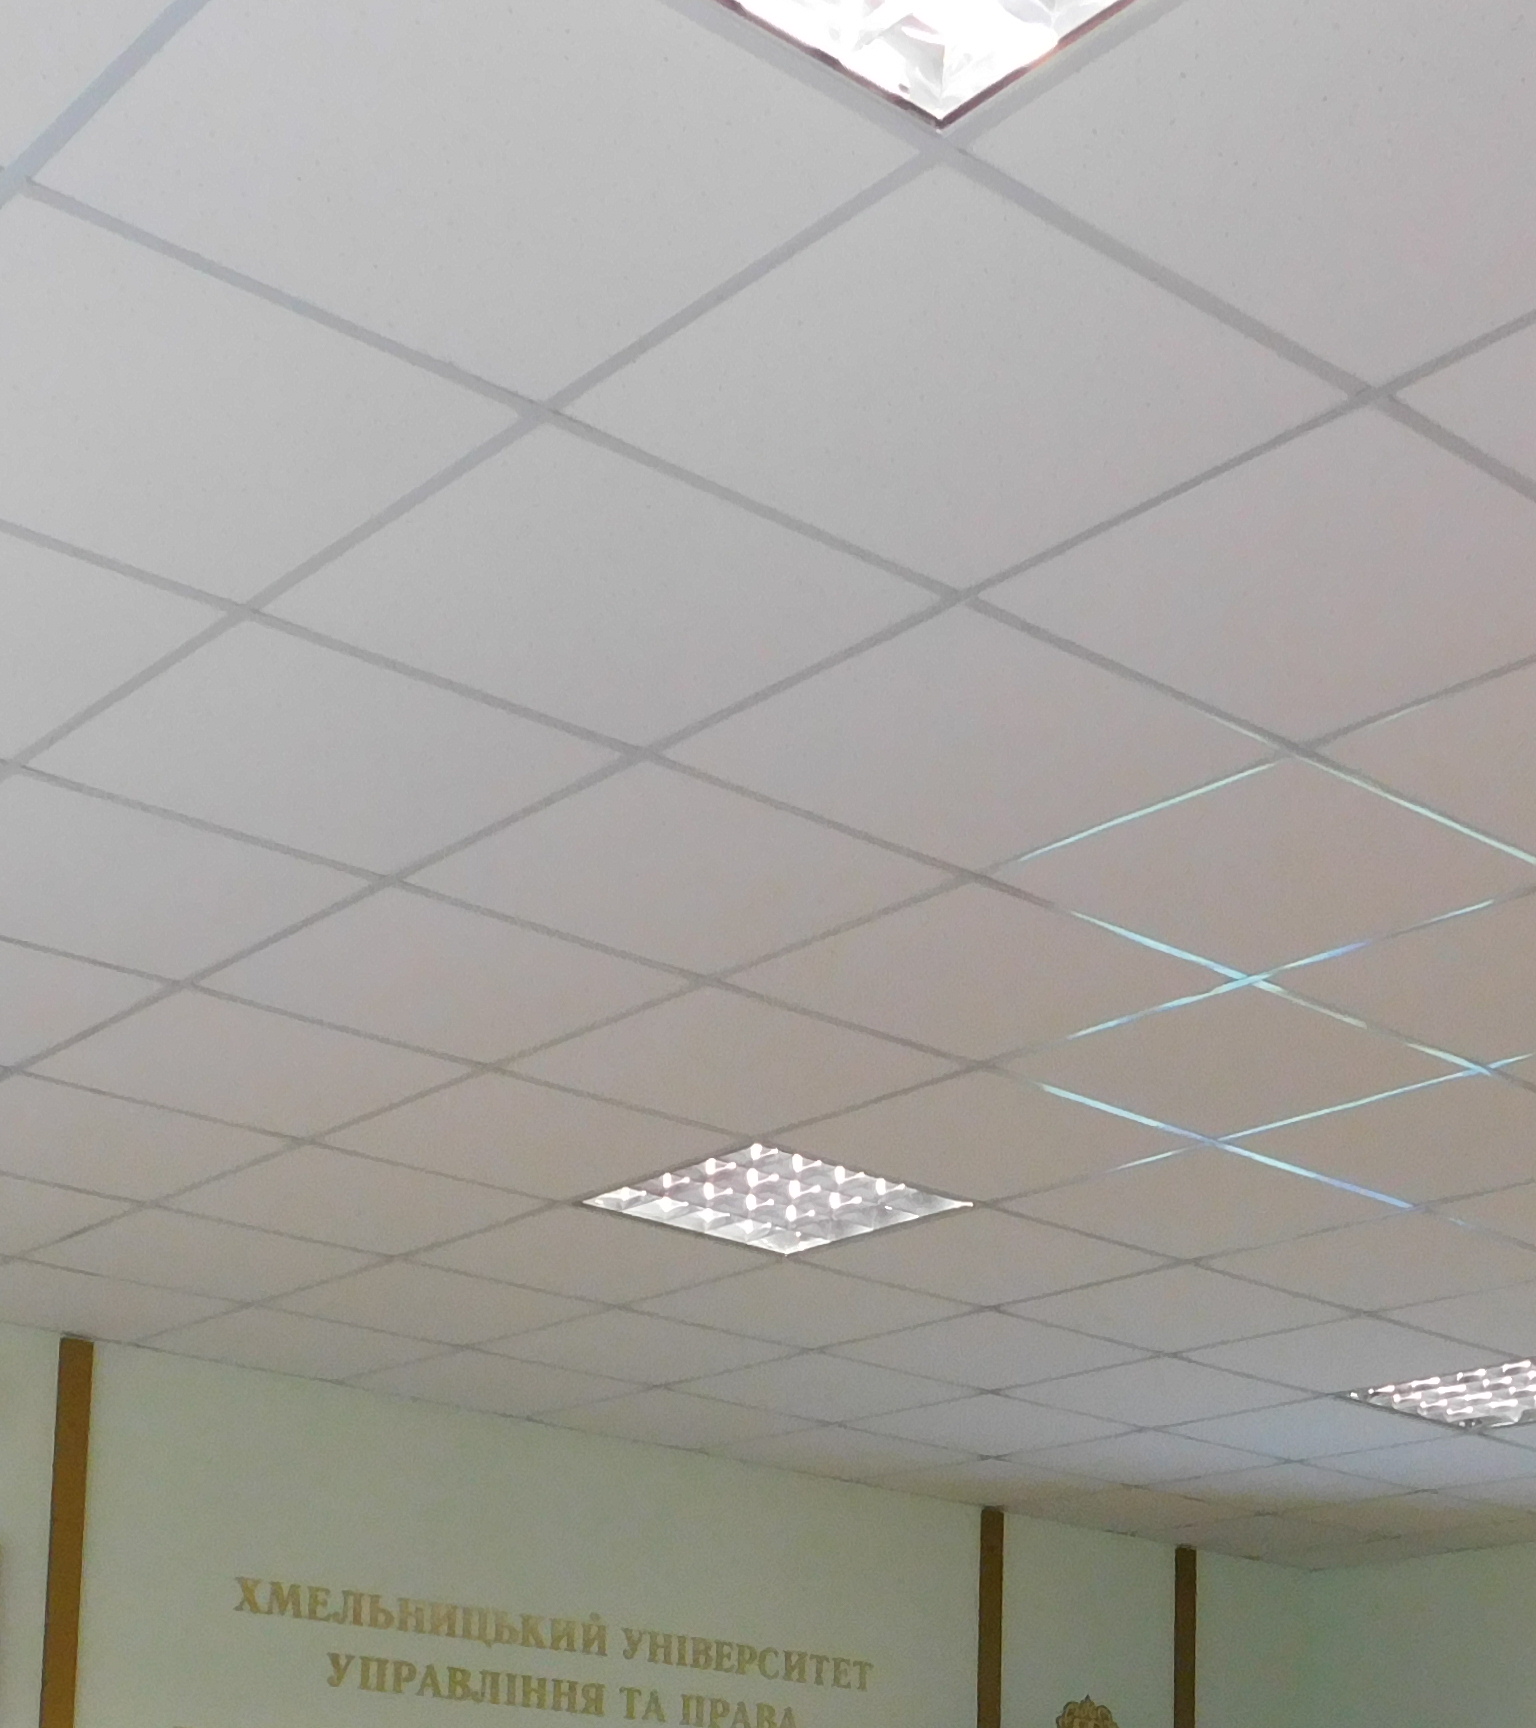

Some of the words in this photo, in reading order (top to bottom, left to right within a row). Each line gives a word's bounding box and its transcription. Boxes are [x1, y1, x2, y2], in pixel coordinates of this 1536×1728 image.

[234, 1576, 609, 1658] ХМЕЛЬНИЦЬКИЙ
[621, 1627, 874, 1693] УНІВЕРСИТЕТ
[326, 1652, 606, 1718] УПРАВЛІННЯ
[619, 1686, 667, 1724] ТА
